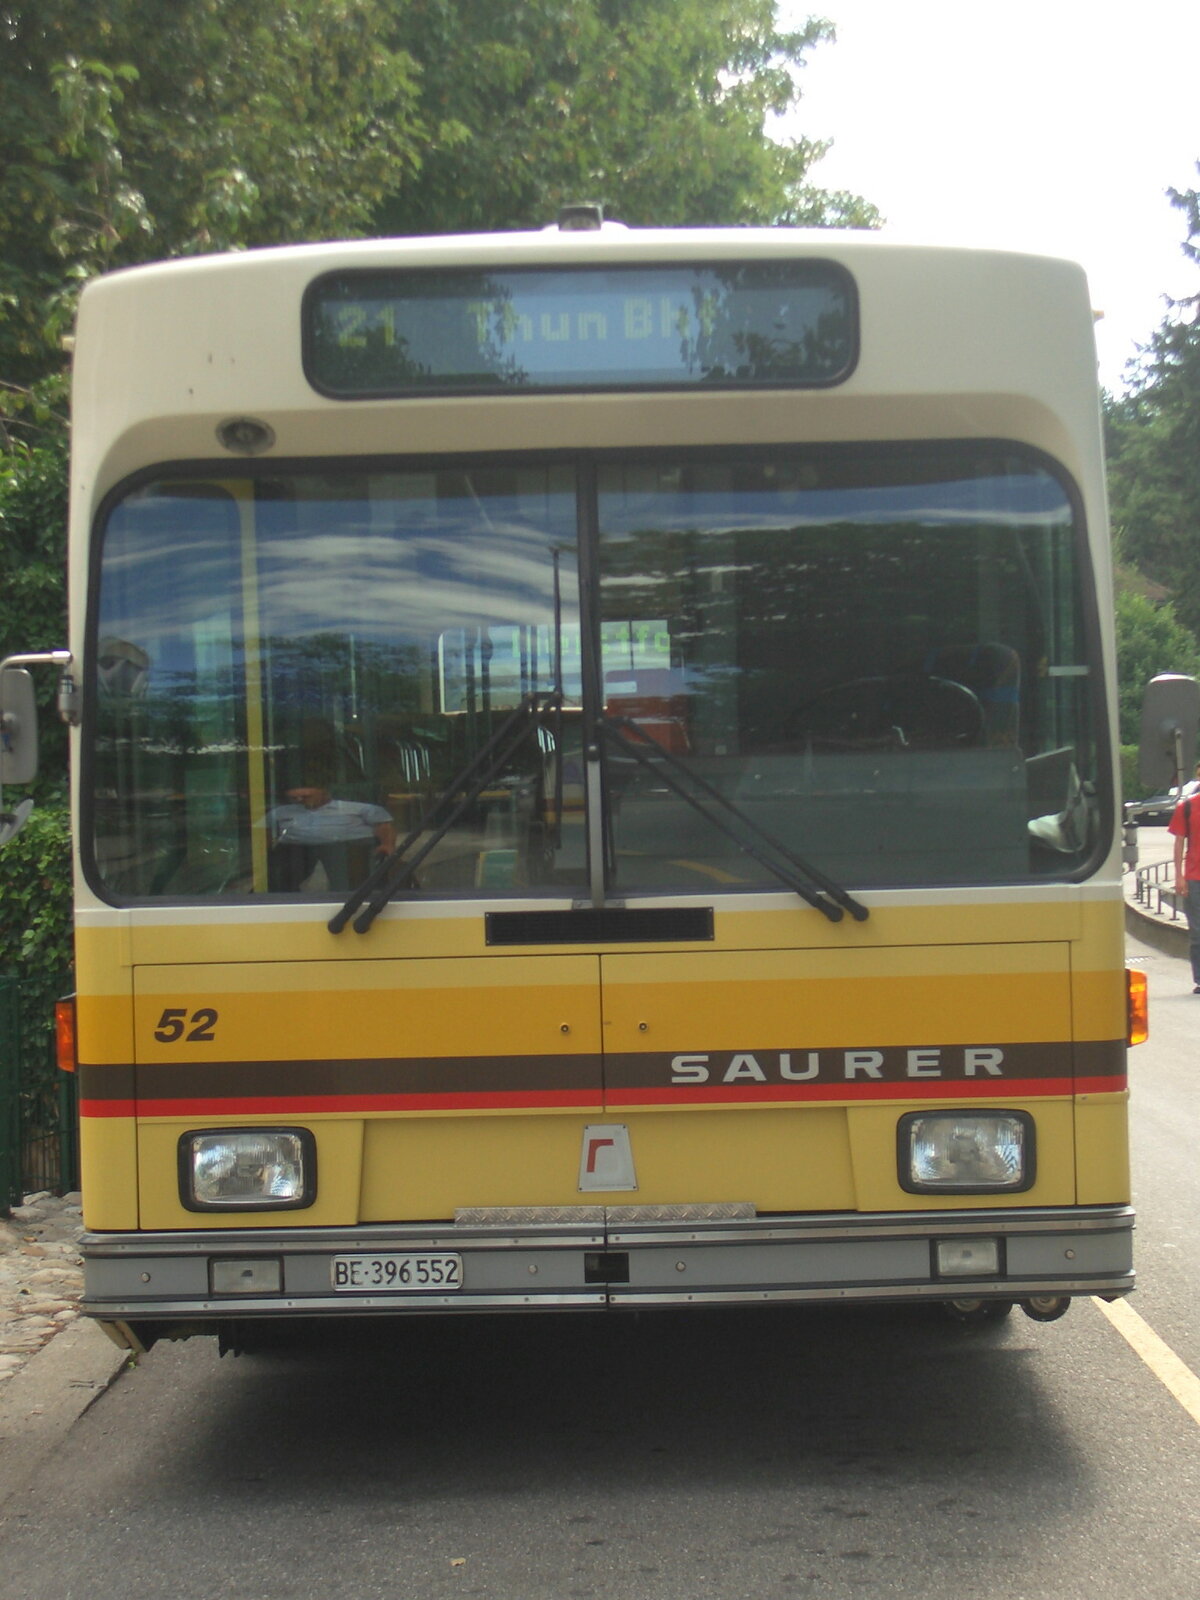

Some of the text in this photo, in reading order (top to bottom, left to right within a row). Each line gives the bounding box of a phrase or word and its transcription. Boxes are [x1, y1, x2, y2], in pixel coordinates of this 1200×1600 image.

[338, 298, 718, 348] 21 Thun Bhf
[155, 1008, 217, 1042] 52
[671, 1048, 1004, 1083] SAURER
